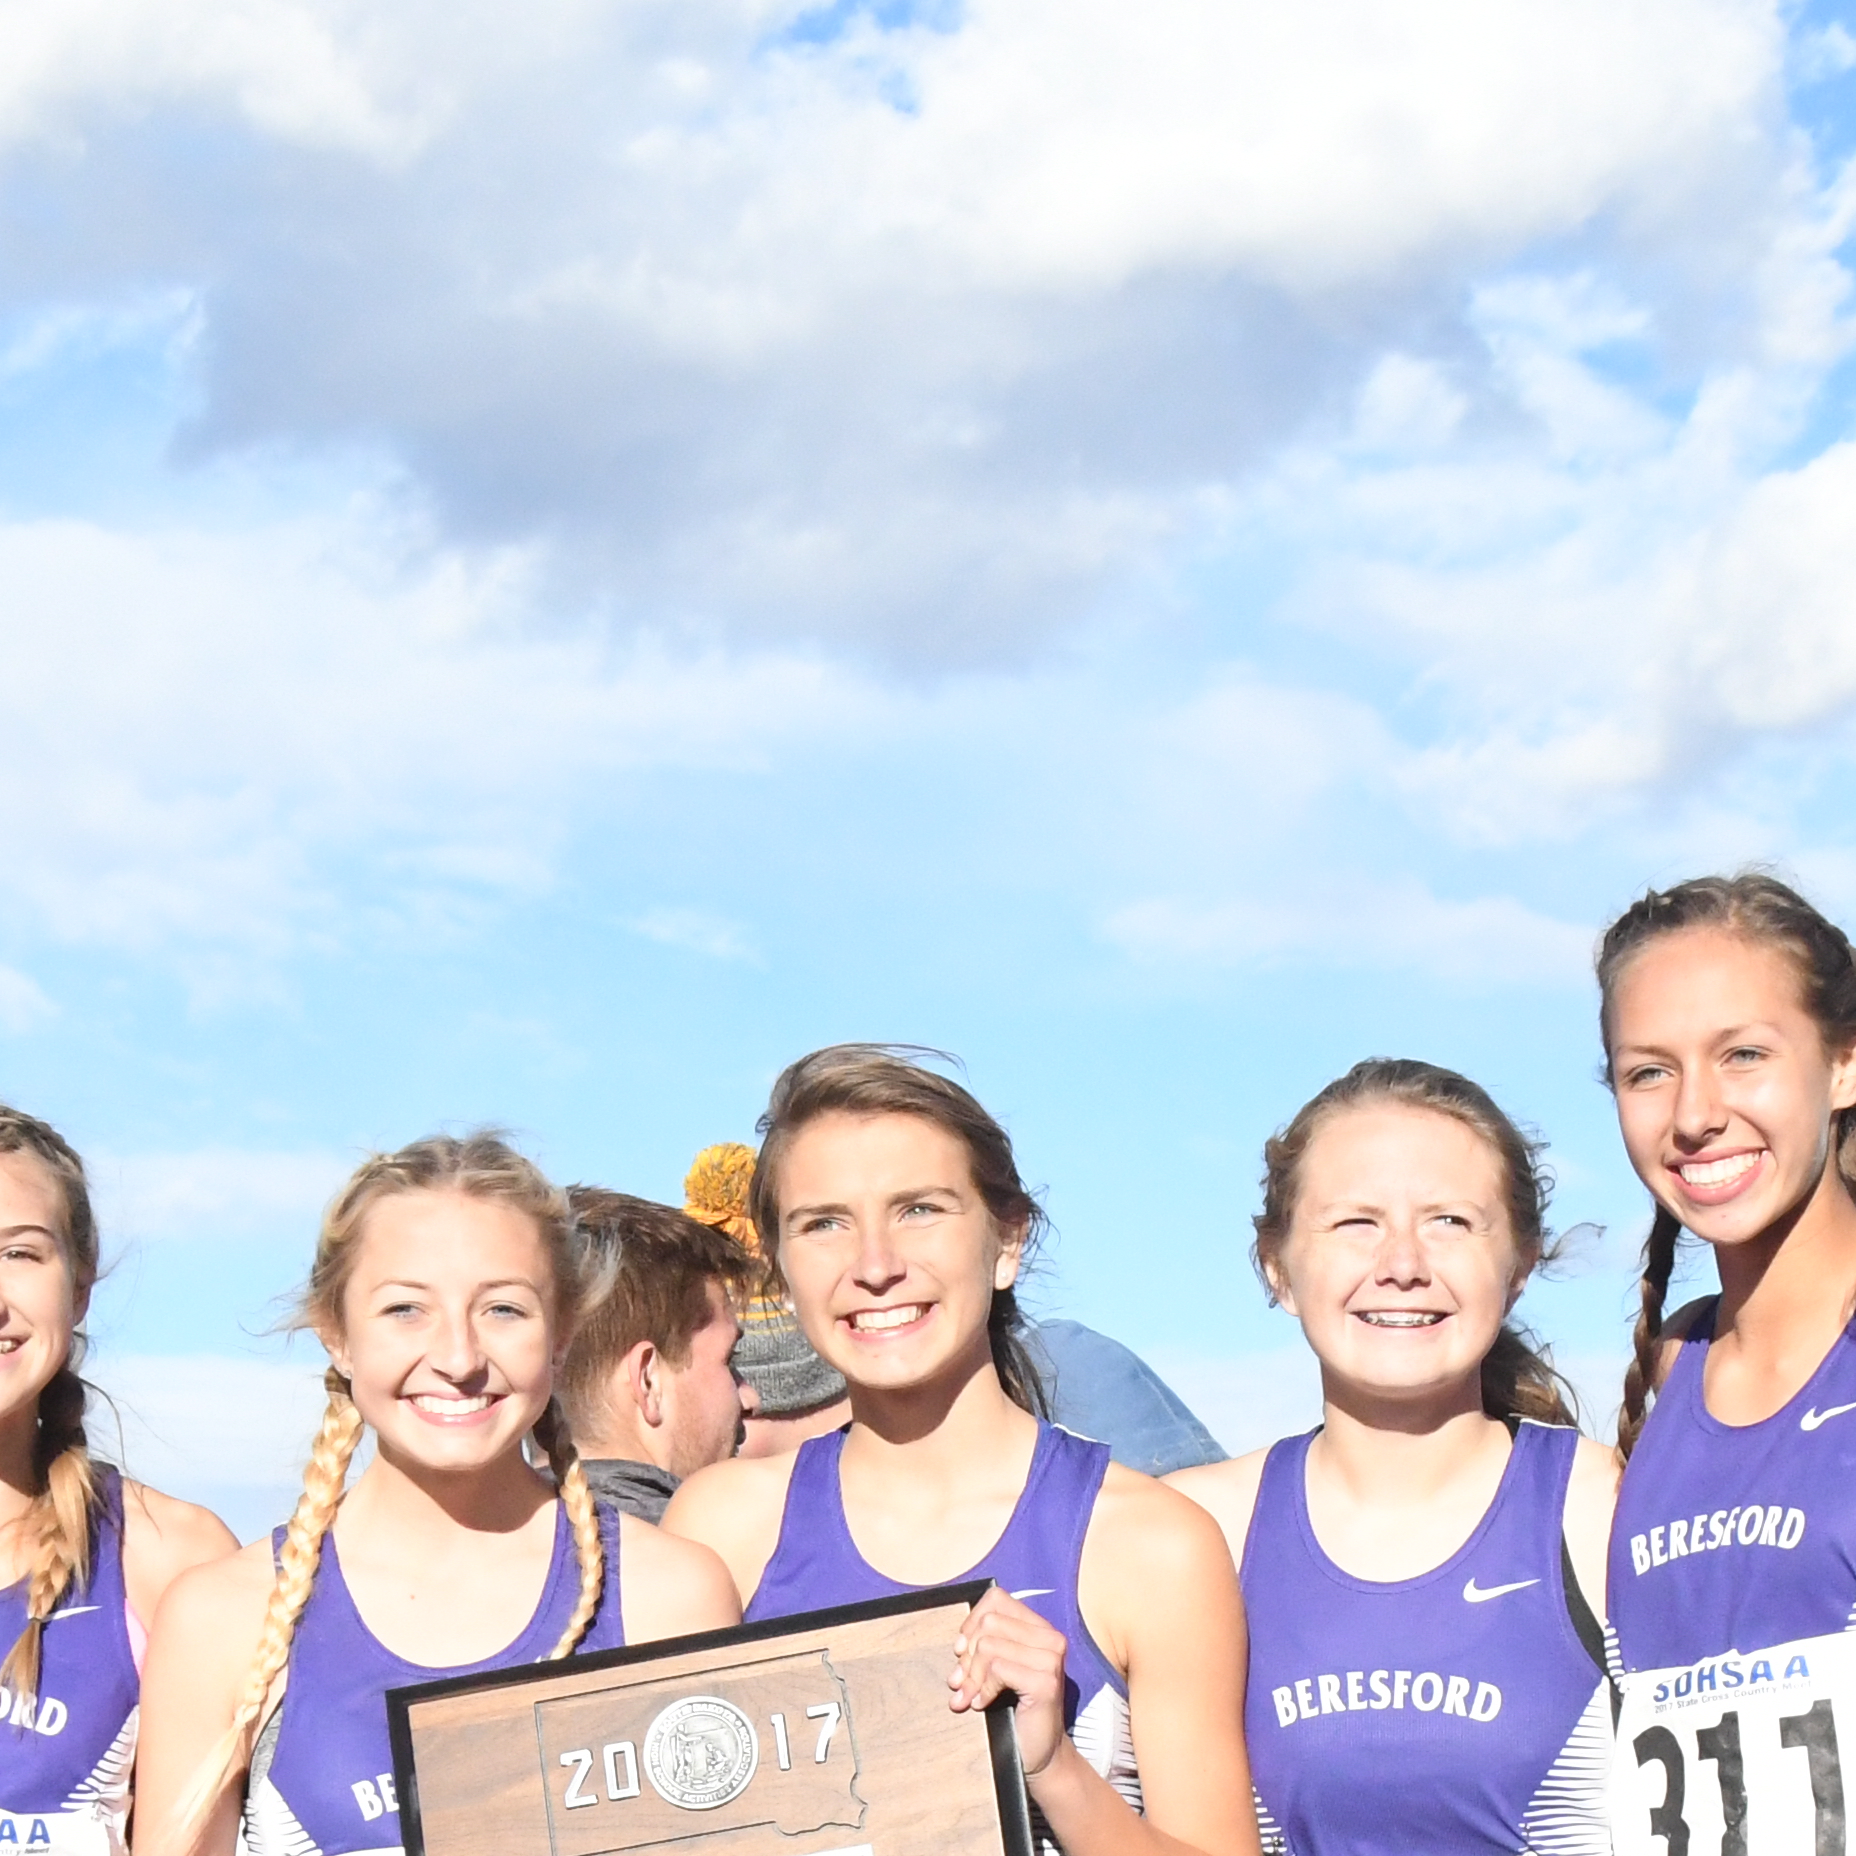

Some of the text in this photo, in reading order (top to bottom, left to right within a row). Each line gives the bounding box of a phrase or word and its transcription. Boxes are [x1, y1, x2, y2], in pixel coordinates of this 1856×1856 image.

[1630, 1505, 1806, 1577] BERESFORD
[1270, 1669, 1503, 1728] BERESFORD
[1652, 1655, 1810, 1703] SDHSAA
[1701, 1693, 1730, 1704] Cross
[1734, 1686, 1778, 1699] Country
